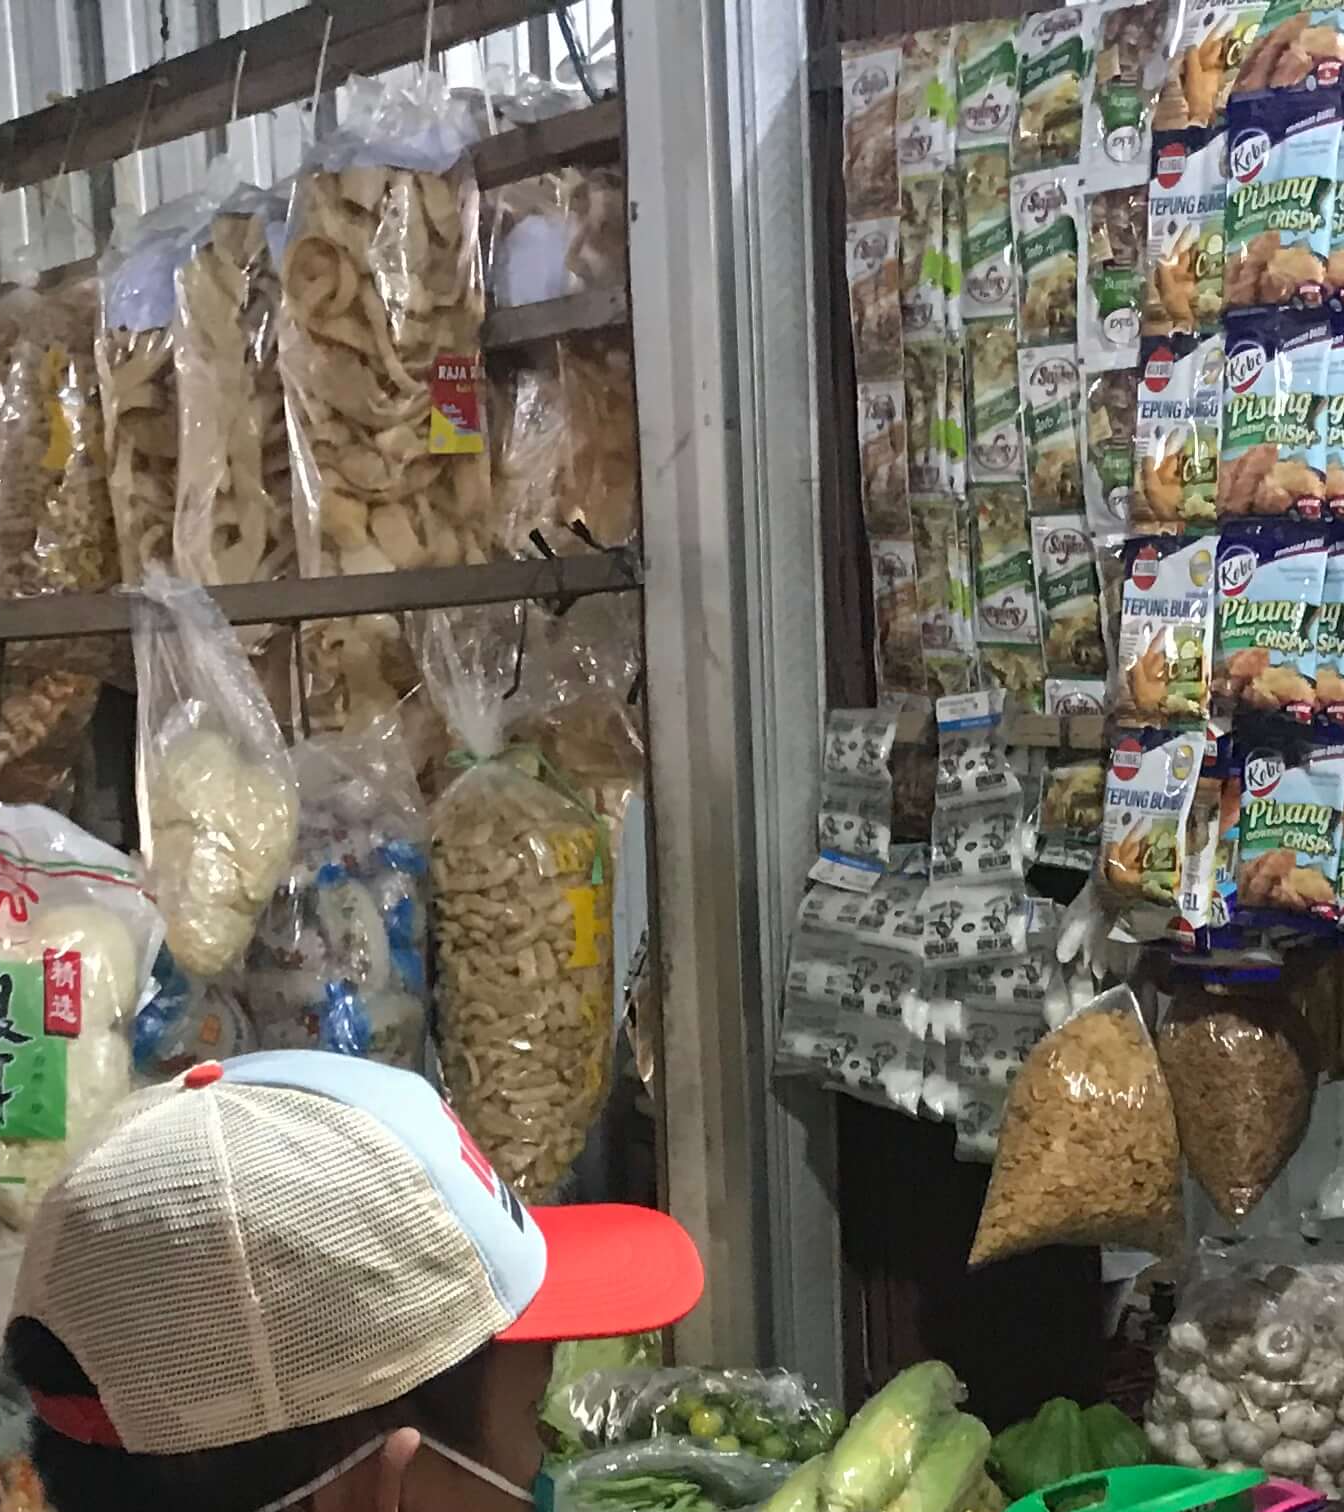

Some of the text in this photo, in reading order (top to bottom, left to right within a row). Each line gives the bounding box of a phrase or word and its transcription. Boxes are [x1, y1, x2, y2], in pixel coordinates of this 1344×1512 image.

[1150, 196, 1195, 216] TEPUNG
[1233, 176, 1318, 217] Pisang
[1268, 207, 1324, 232] CRISPY
[438, 365, 467, 379] RAJA
[1228, 353, 1264, 381] Kobe
[1264, 423, 1322, 447] CRISPY
[1124, 598, 1168, 616] TEPUNG
[1219, 599, 1306, 636] Pisang
[1255, 627, 1310, 651] CRISPY
[1107, 788, 1150, 808] TEPUNG
[1246, 801, 1334, 833] Pisang
